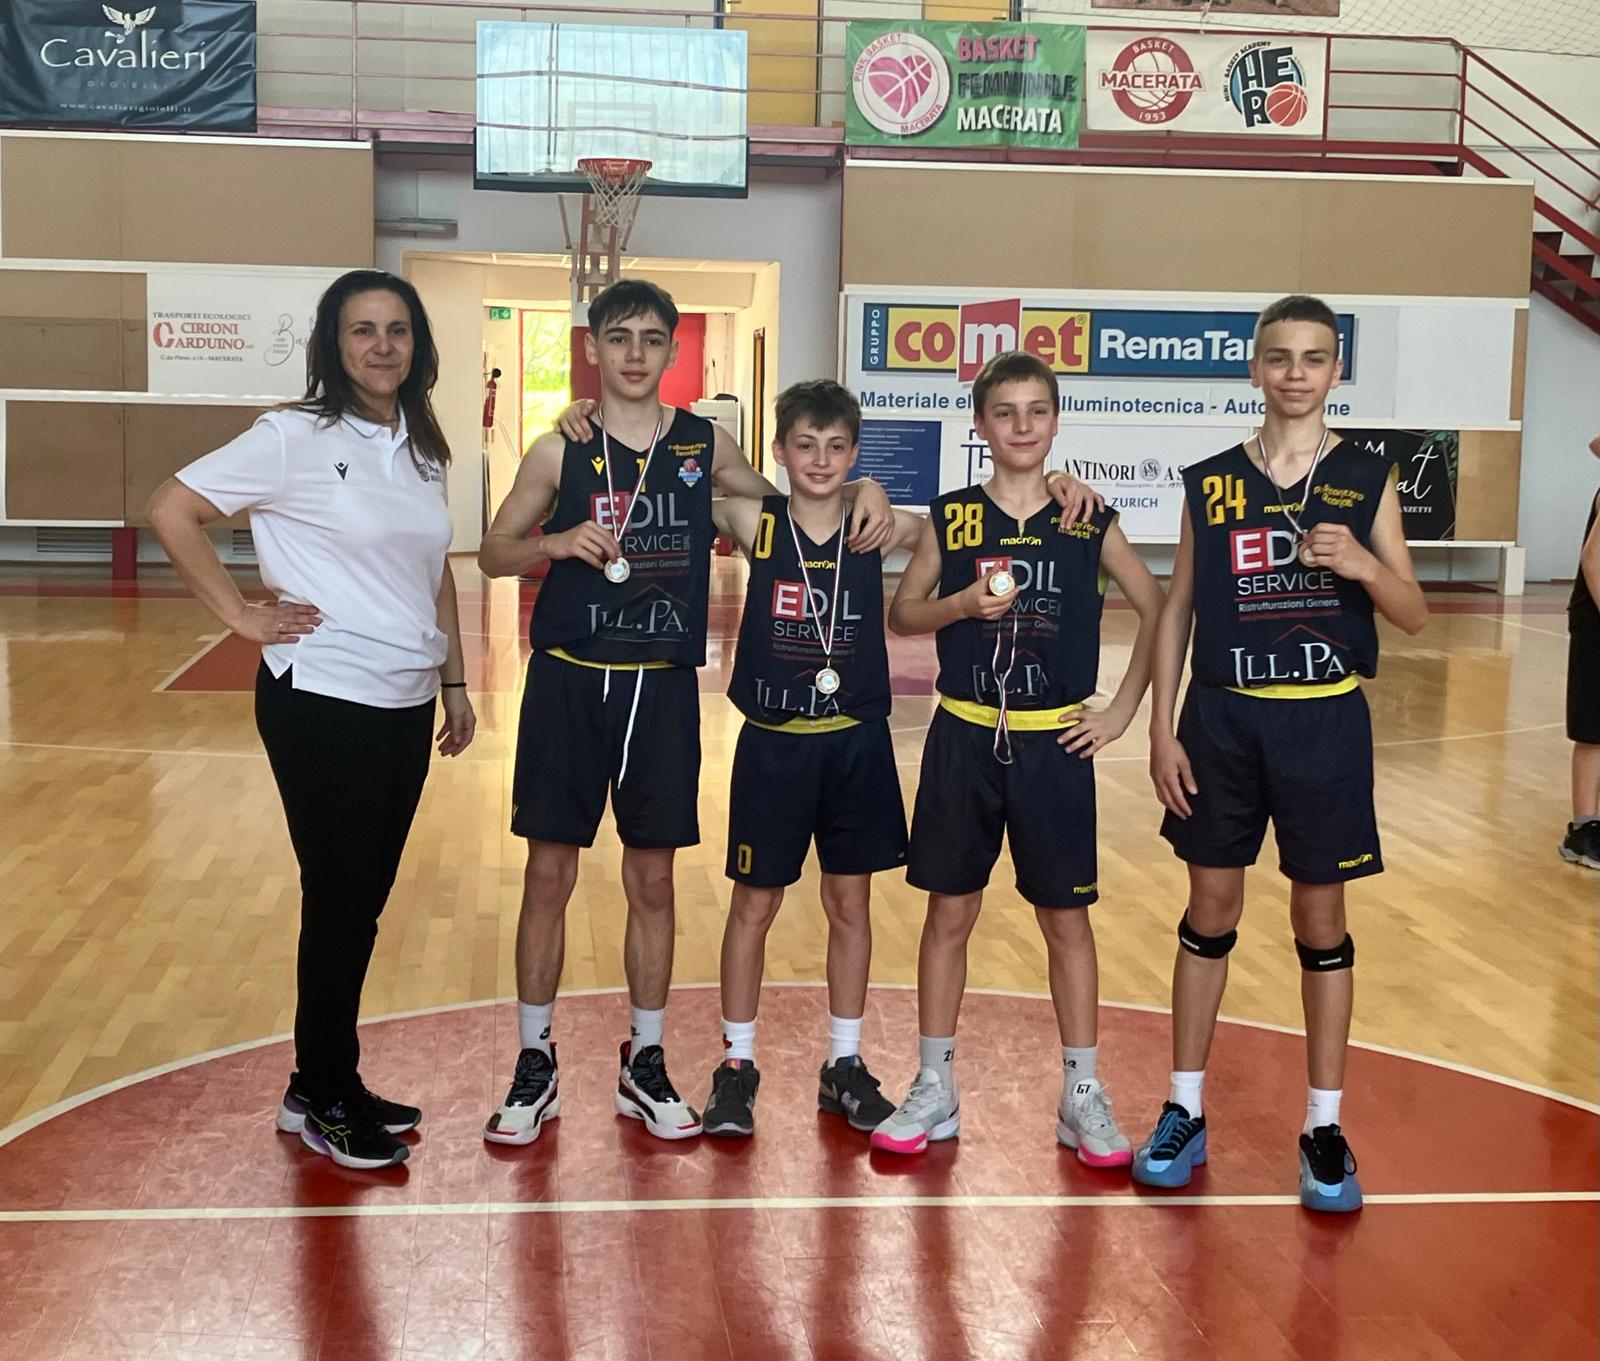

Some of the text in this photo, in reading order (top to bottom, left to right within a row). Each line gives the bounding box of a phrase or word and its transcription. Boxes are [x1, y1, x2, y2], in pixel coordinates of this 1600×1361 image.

[40, 29, 206, 71] Cavalieri
[853, 34, 902, 83] PINK BASKET
[958, 35, 1039, 62] BASKET
[1132, 41, 1175, 53] BASKET
[1101, 72, 1203, 90] MACERATA
[901, 103, 943, 134] MACERATA
[957, 105, 1063, 134] MACERATA
[1138, 112, 1166, 122] 1953
[181, 322, 239, 335] CIRIONI
[203, 313, 251, 321] ECOLOGICI
[870, 308, 880, 365] GRUPPO
[894, 316, 1083, 367] comet
[860, 391, 949, 409] Materiale
[1064, 458, 1136, 481] ANTINORI
[595, 493, 689, 529] EDIL
[1111, 497, 1158, 508] ZURICH
[1202, 474, 1247, 527] 24
[944, 503, 984, 551] 28
[625, 534, 682, 553] RVICE
[1000, 536, 1042, 546] macron
[1237, 572, 1335, 595] SERVICE
[776, 584, 862, 620] EDL
[737, 843, 753, 875] 0
[1338, 853, 1373, 869] macron
[1077, 1084, 1092, 1094] GT
